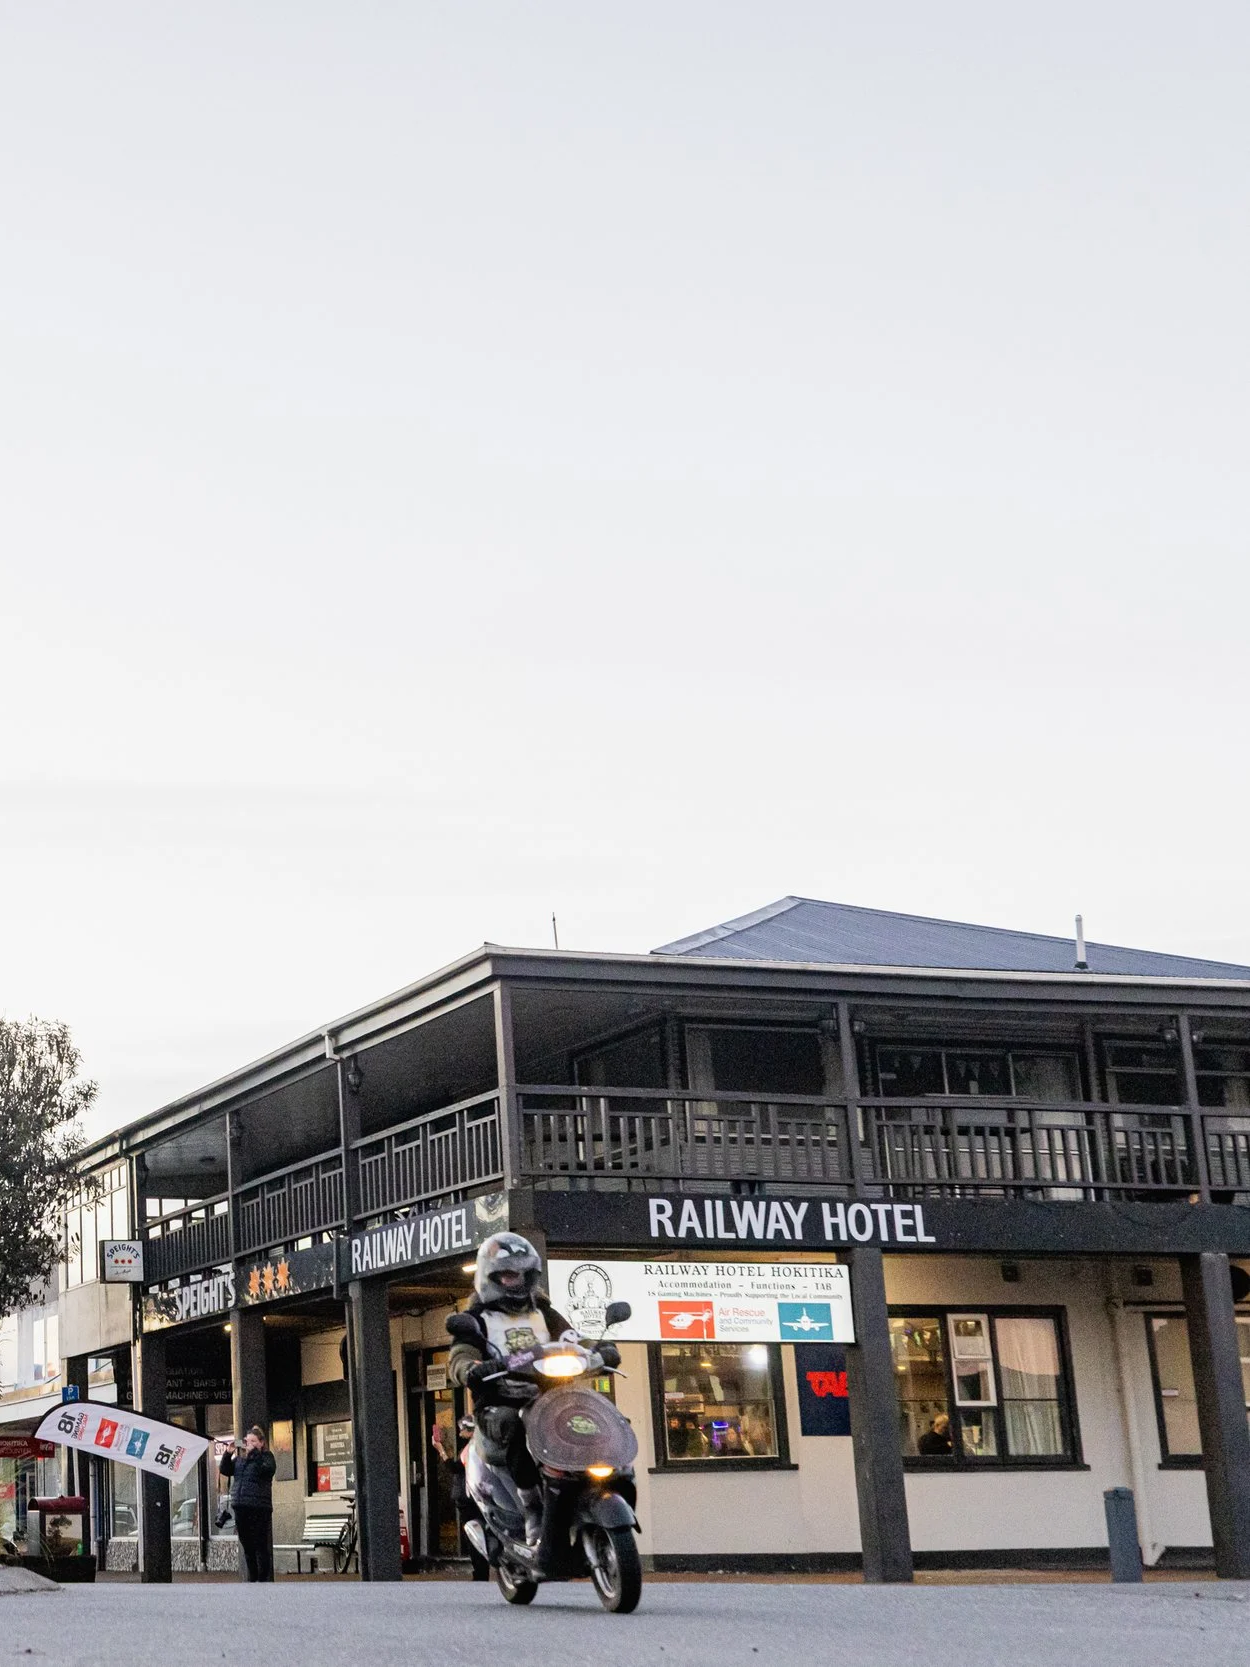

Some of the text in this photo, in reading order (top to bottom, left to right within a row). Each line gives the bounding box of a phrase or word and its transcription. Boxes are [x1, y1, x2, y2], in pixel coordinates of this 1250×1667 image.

[649, 1198, 937, 1243] RAILWAY HOTEL
[352, 1208, 472, 1274] RAILWAY HOTEL
[643, 1264, 844, 1279] RAILWAY HOTEL HOKITIKA
[658, 1280, 832, 1291] Accommodation Functions TAB
[175, 1269, 236, 1321] SPEIGHT'S
[718, 1307, 766, 1317] Air Rescue
[718, 1317, 774, 1326] and Community
[67, 1387, 74, 1396] P
